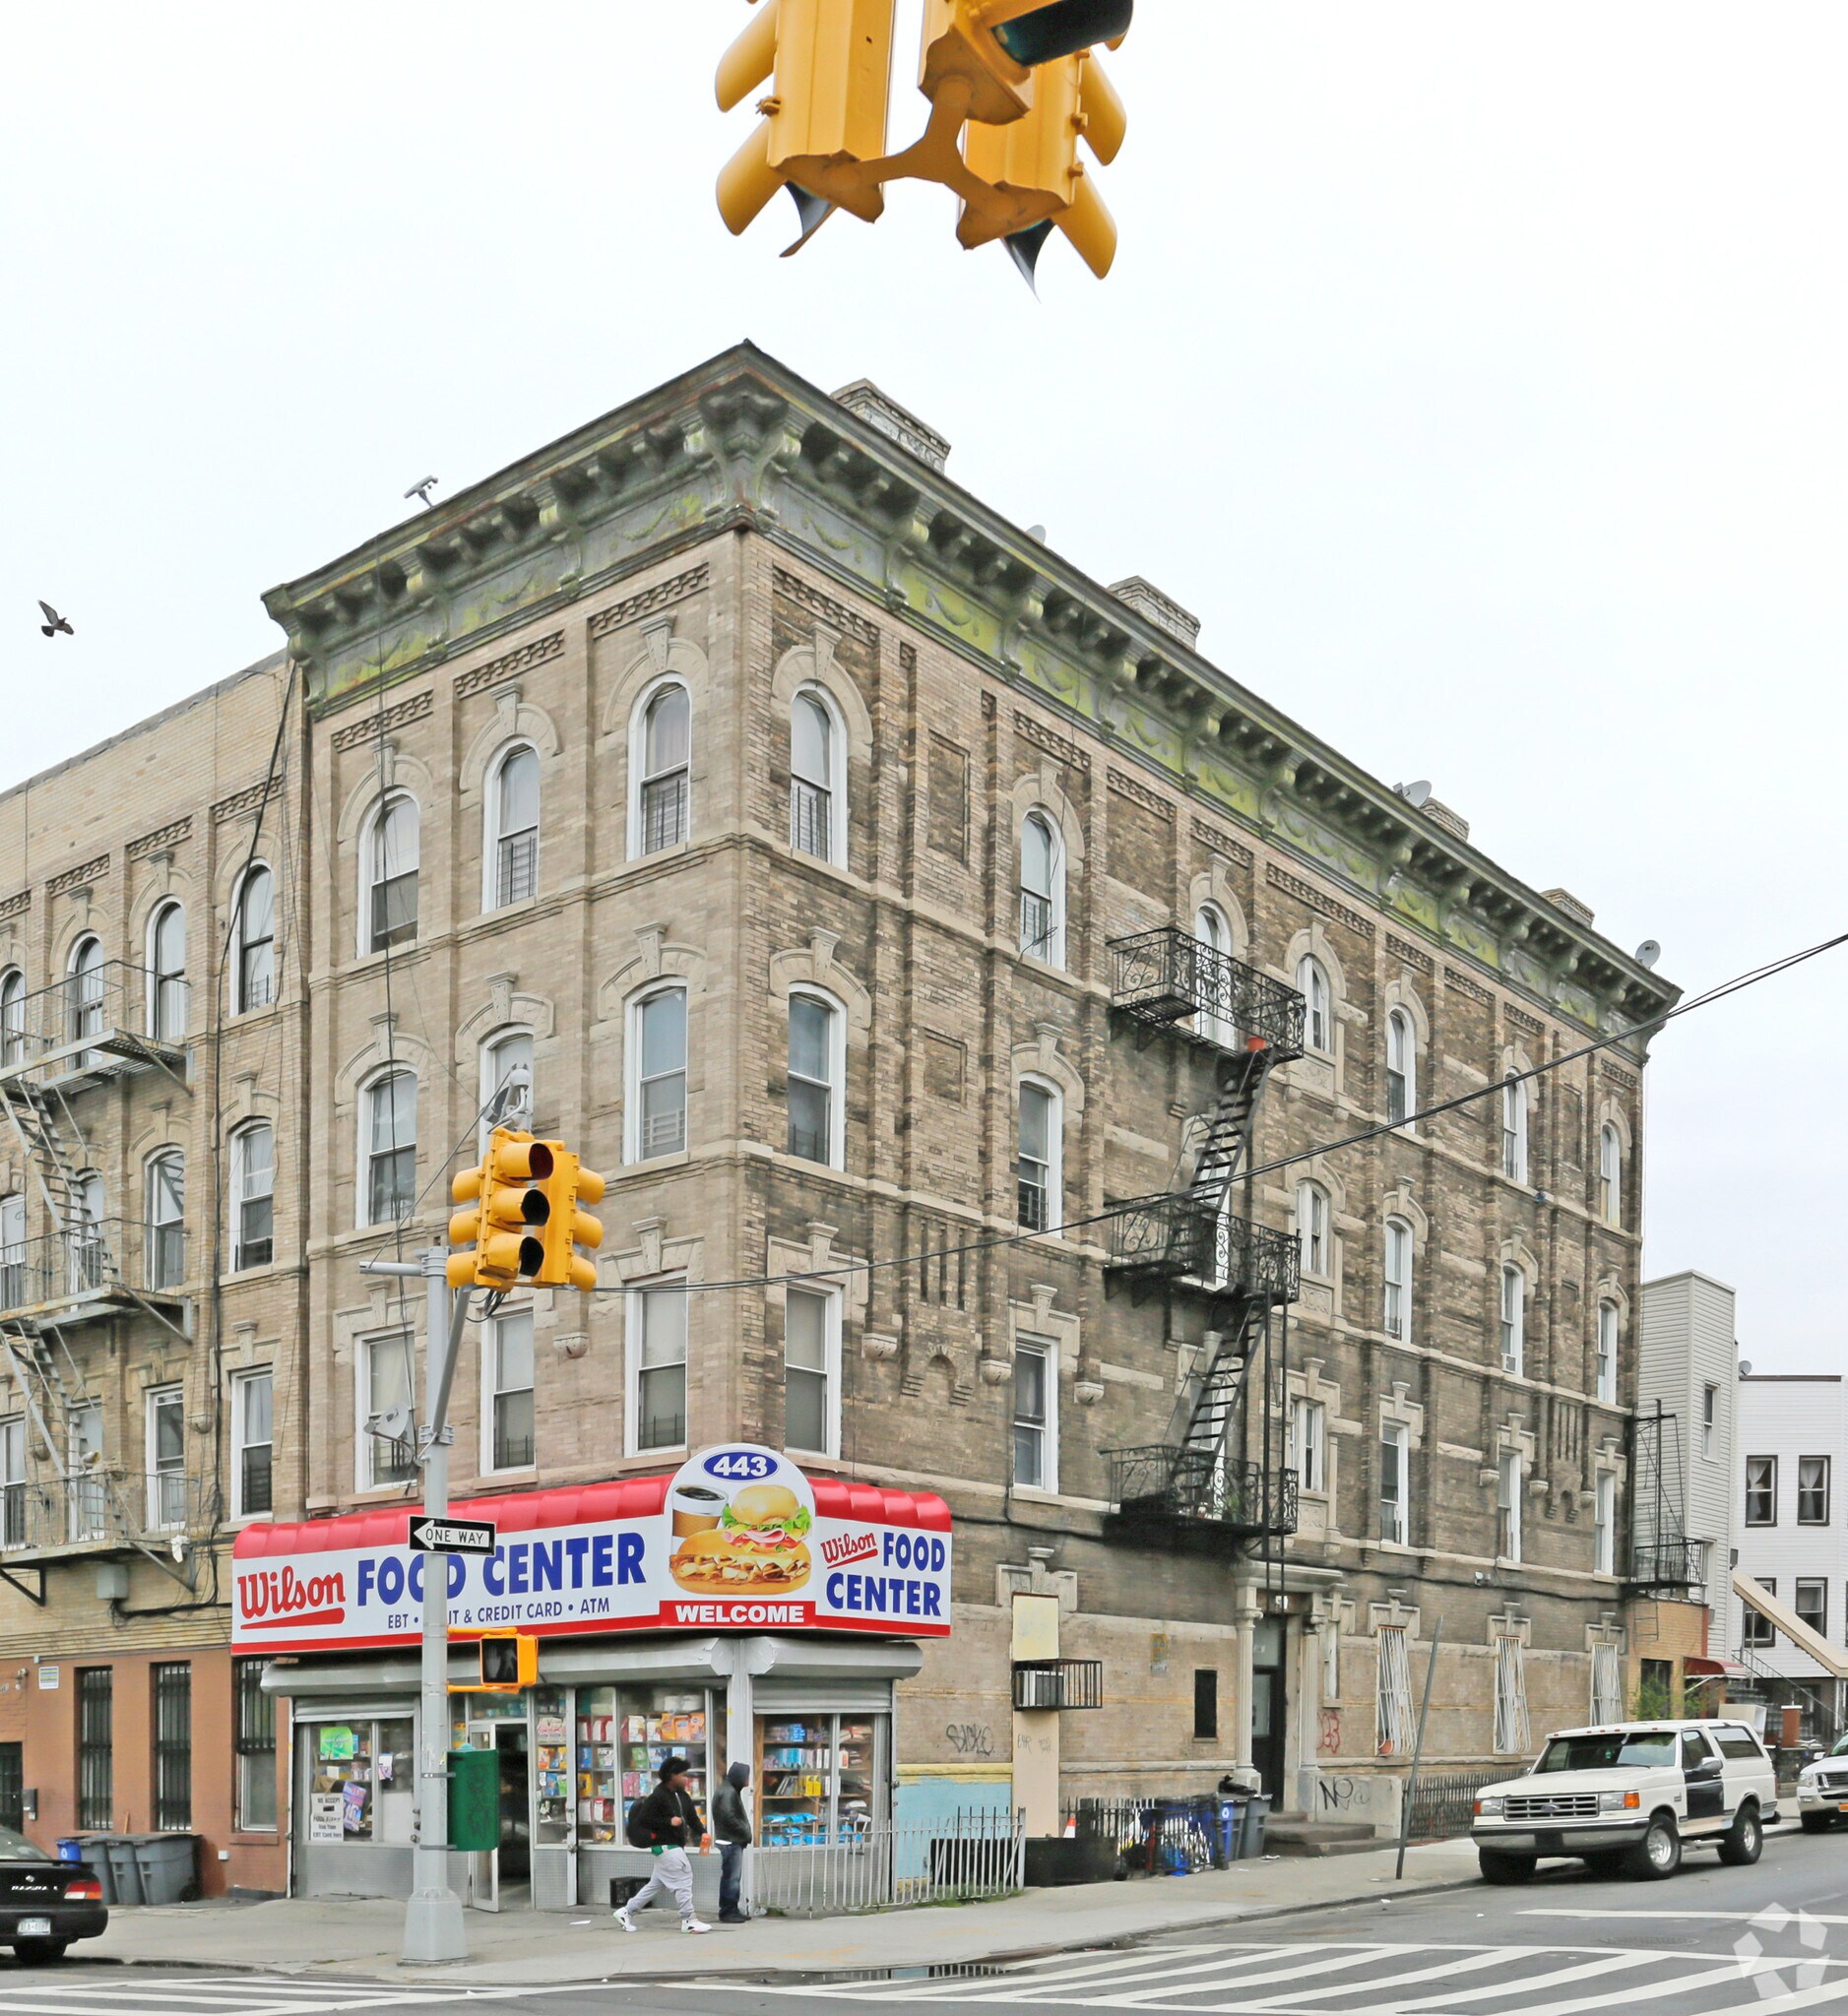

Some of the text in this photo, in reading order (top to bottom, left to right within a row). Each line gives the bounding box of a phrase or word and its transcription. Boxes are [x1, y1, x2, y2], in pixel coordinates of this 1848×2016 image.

[713, 1456, 768, 1477] 443
[425, 1528, 484, 1544] ONE WAY
[820, 1531, 945, 1572] Wilson FOOD
[237, 1565, 346, 1619] Wilson
[482, 1532, 647, 1597] CENTER
[826, 1572, 941, 1617] CENTER
[388, 1613, 409, 1629] EBT
[464, 1608, 473, 1624] &
[478, 1604, 523, 1622] CREDIT
[527, 1601, 562, 1618] CARD
[580, 1597, 609, 1614] ATM
[675, 1605, 804, 1623] WELCOME
